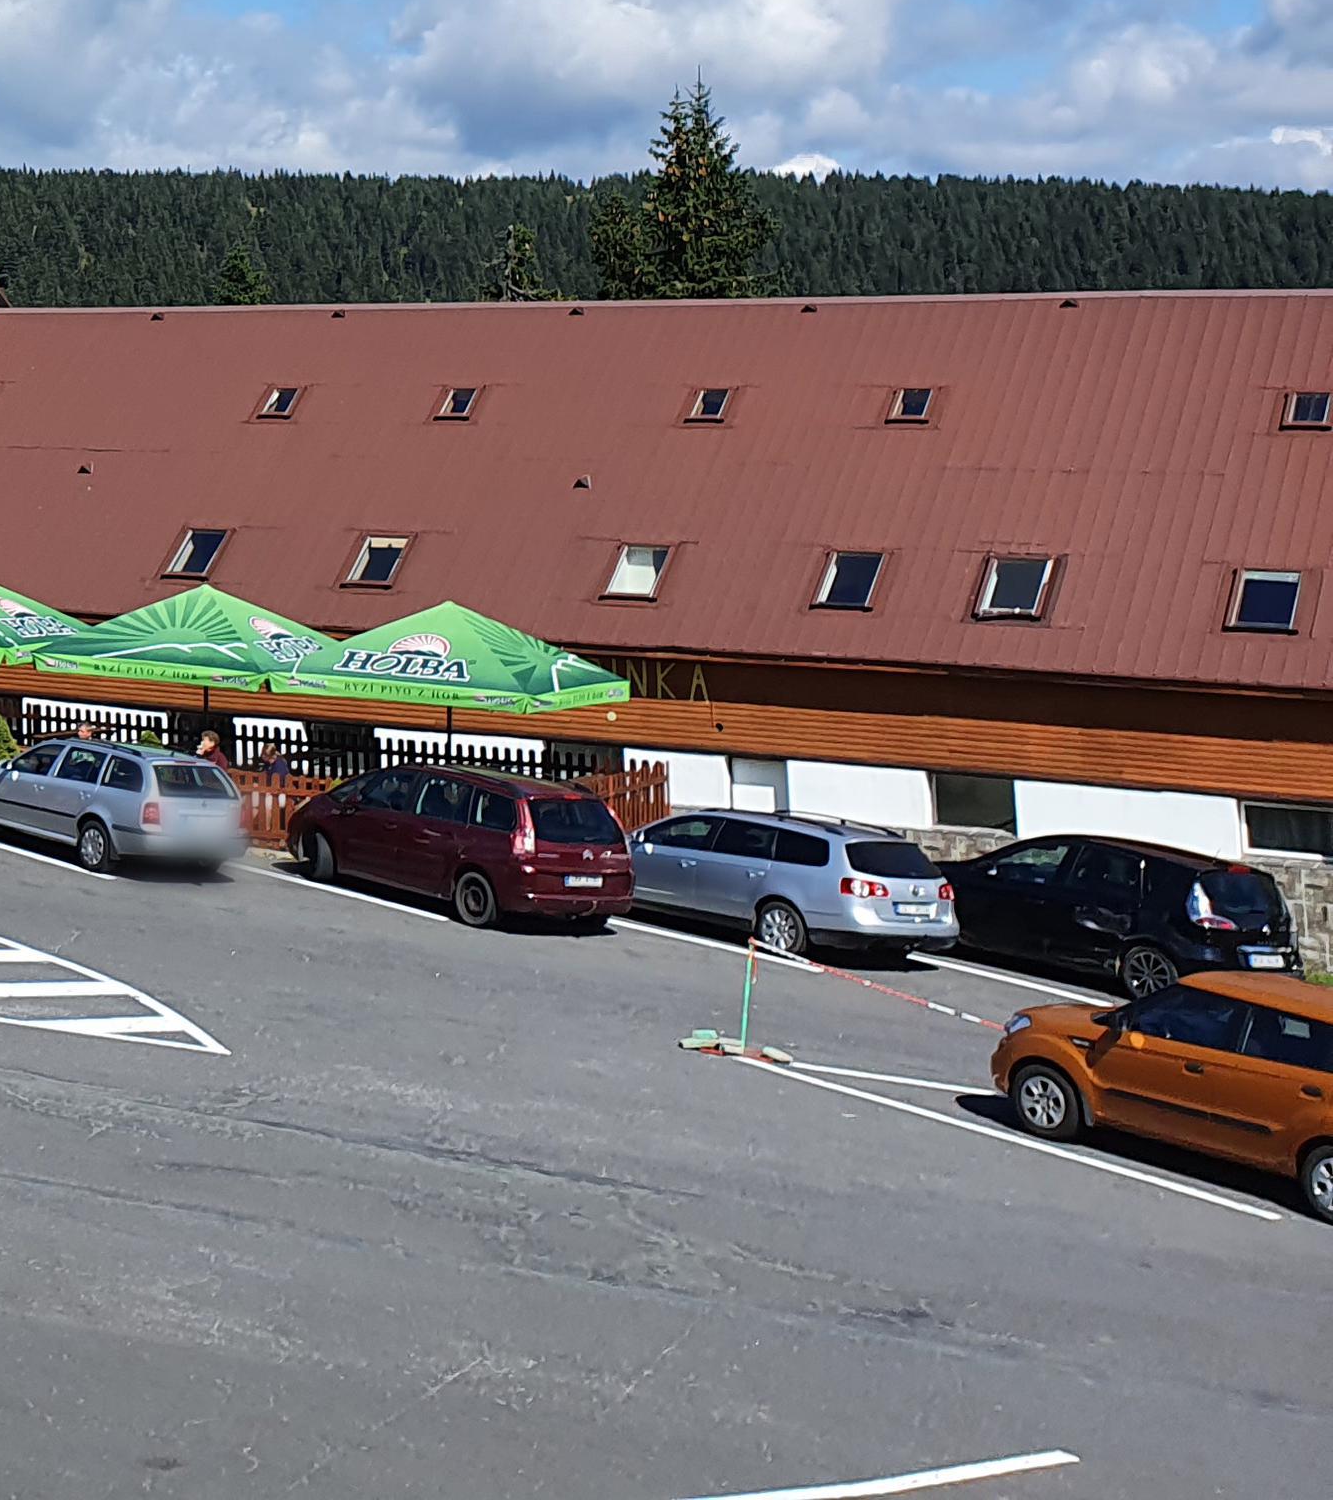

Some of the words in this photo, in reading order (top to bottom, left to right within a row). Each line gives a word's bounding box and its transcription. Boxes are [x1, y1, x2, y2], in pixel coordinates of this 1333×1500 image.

[332, 648, 472, 683] HOLBA
[343, 680, 374, 693] RYZÍ
[380, 685, 412, 696] PIVO
